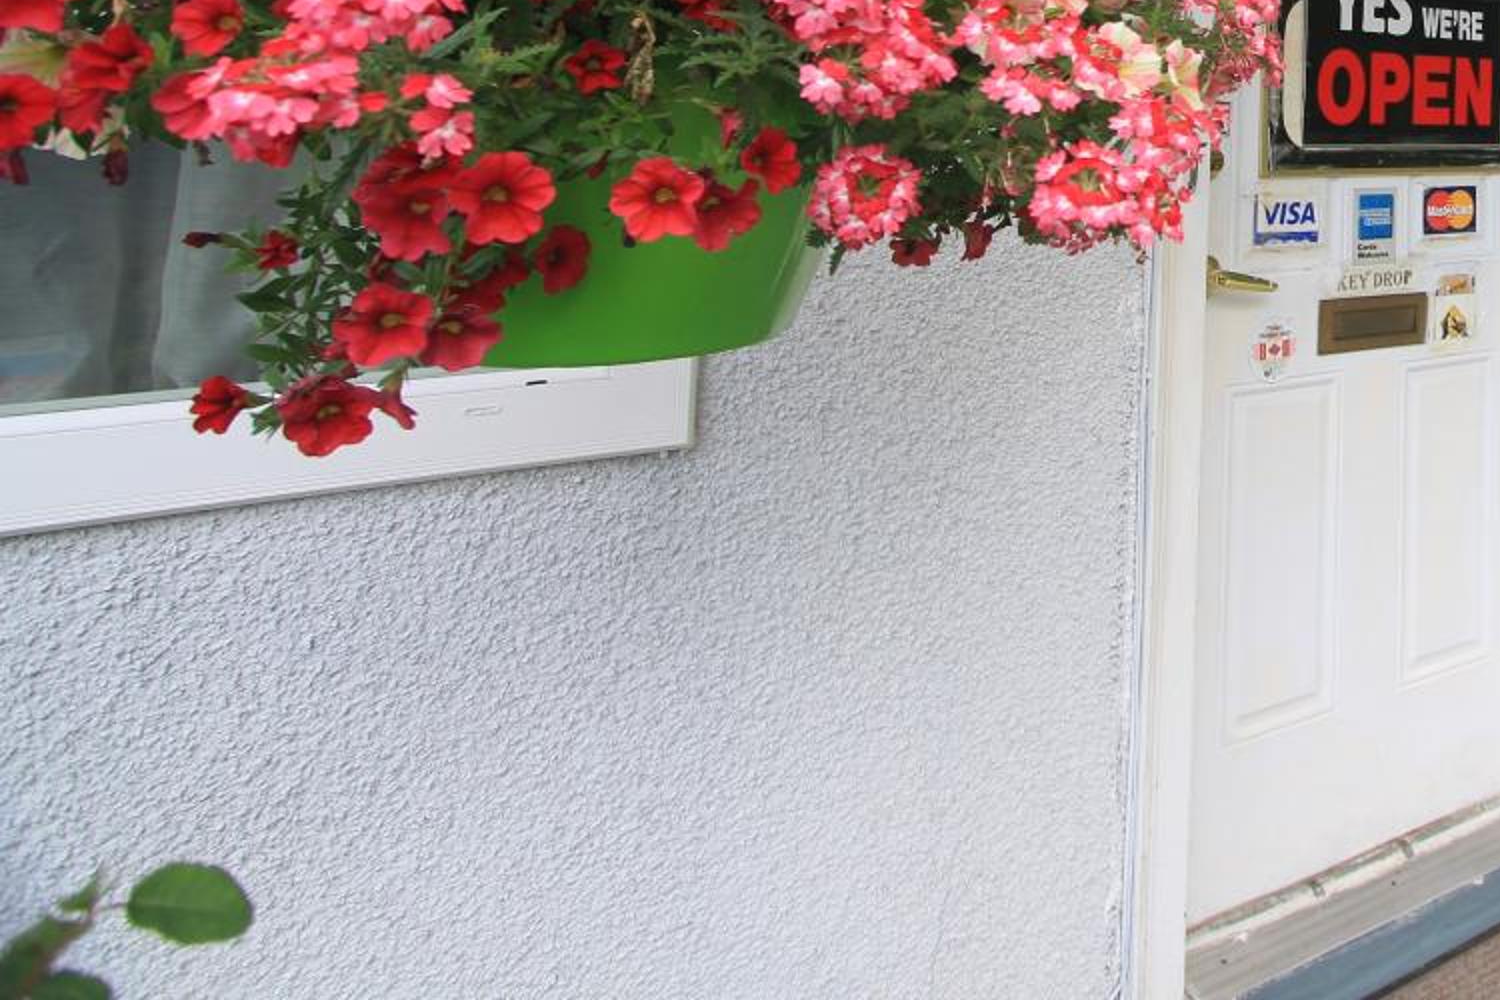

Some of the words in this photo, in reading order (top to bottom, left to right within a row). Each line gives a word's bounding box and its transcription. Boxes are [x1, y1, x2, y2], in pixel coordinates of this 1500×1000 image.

[1421, 6, 1484, 41] WE'RE
[1317, 47, 1493, 127] OPEN
[1264, 201, 1316, 225] VISA
[1337, 270, 1371, 292] KEY
[1373, 269, 1413, 289] DROP
